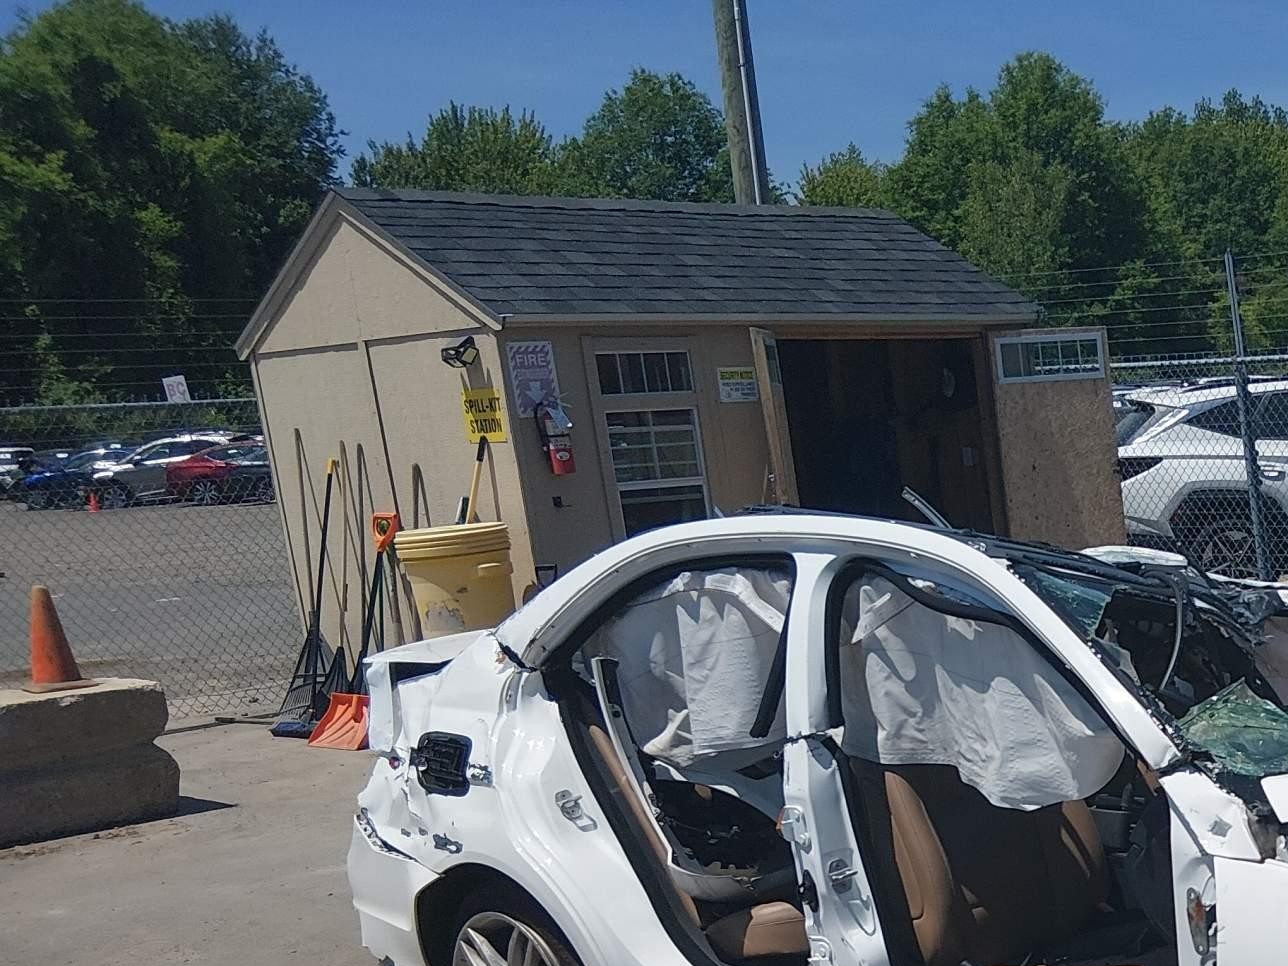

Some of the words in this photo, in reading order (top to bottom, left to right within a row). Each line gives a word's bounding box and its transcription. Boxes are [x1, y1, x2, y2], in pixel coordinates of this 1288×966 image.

[514, 353, 547, 367] FIRE
[463, 397, 502, 415] SPILL-KIT
[469, 418, 503, 434] STATION
